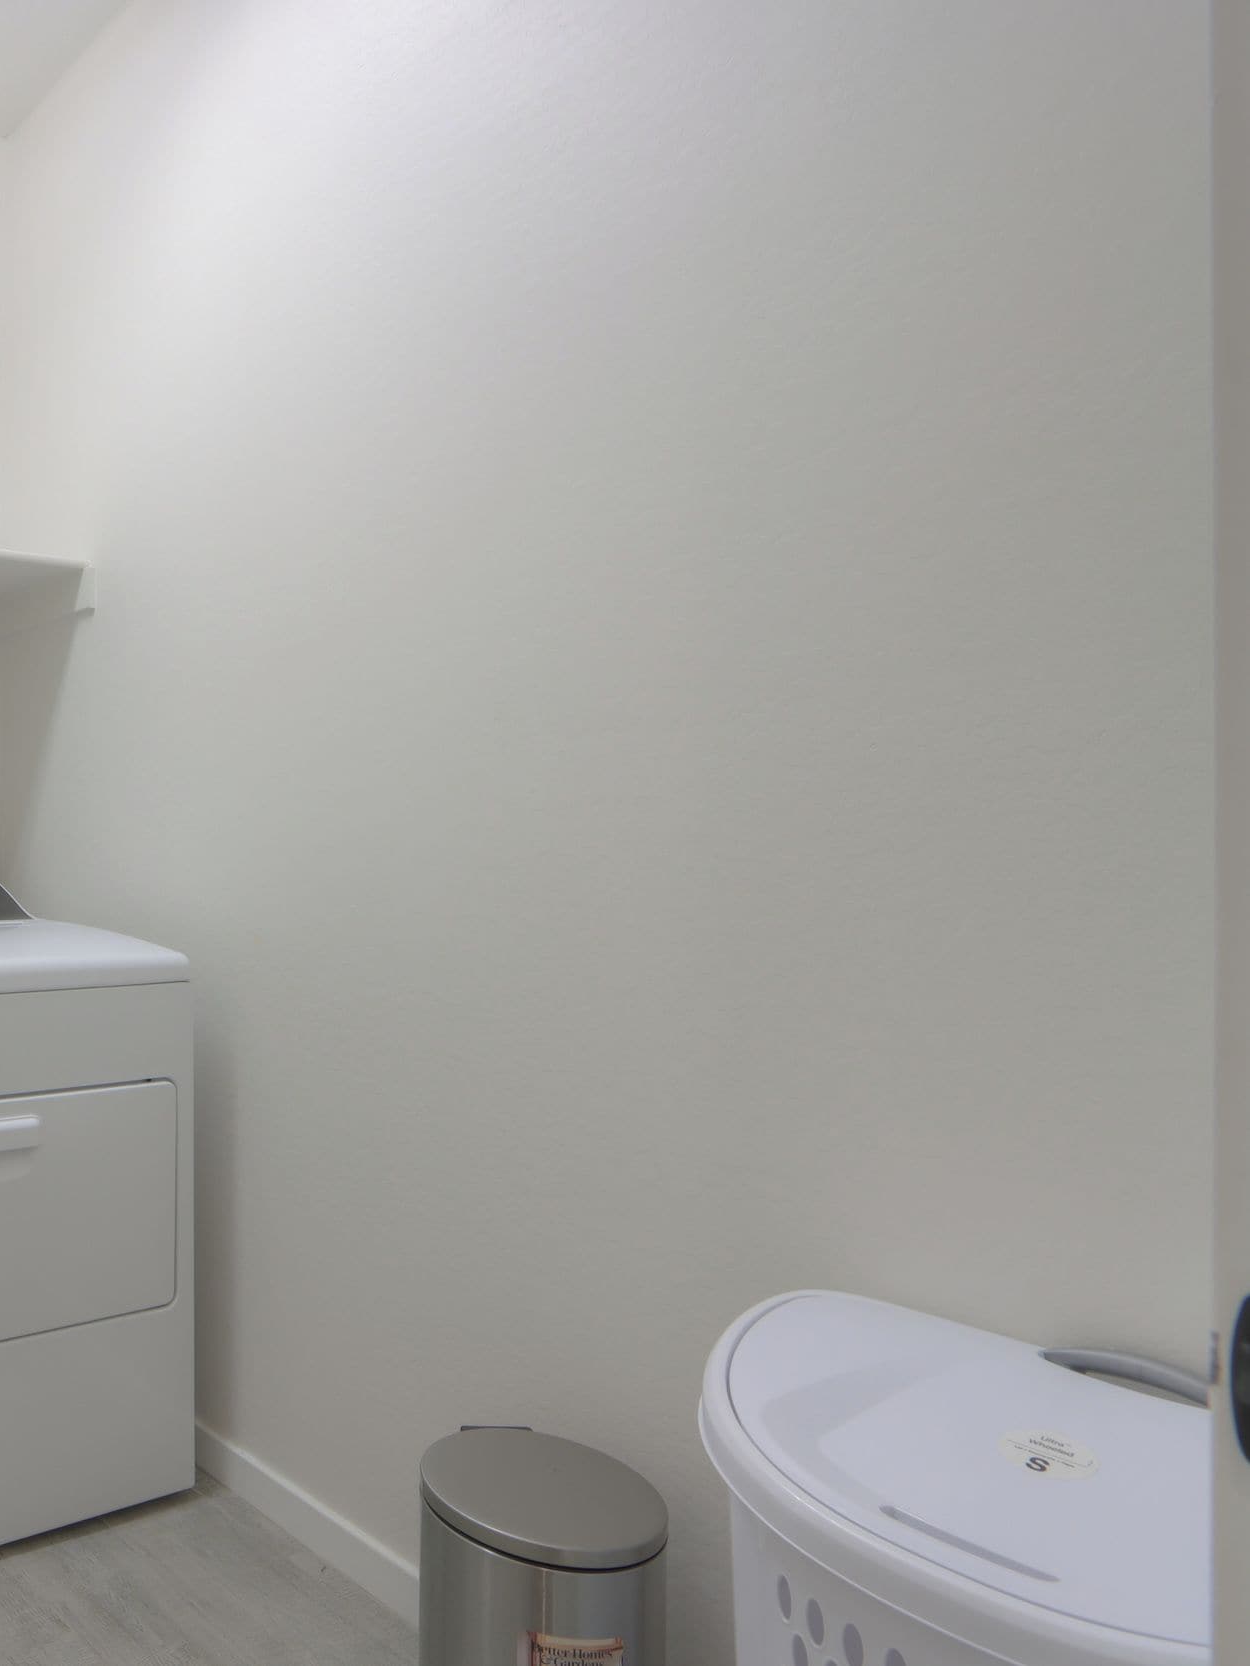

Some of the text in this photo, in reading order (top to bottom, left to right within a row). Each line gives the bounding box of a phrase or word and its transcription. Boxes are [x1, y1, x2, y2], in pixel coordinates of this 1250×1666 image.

[1041, 1436, 1064, 1447] Ultra
[1026, 1457, 1050, 1472] S
[573, 1648, 612, 1659] Homes
